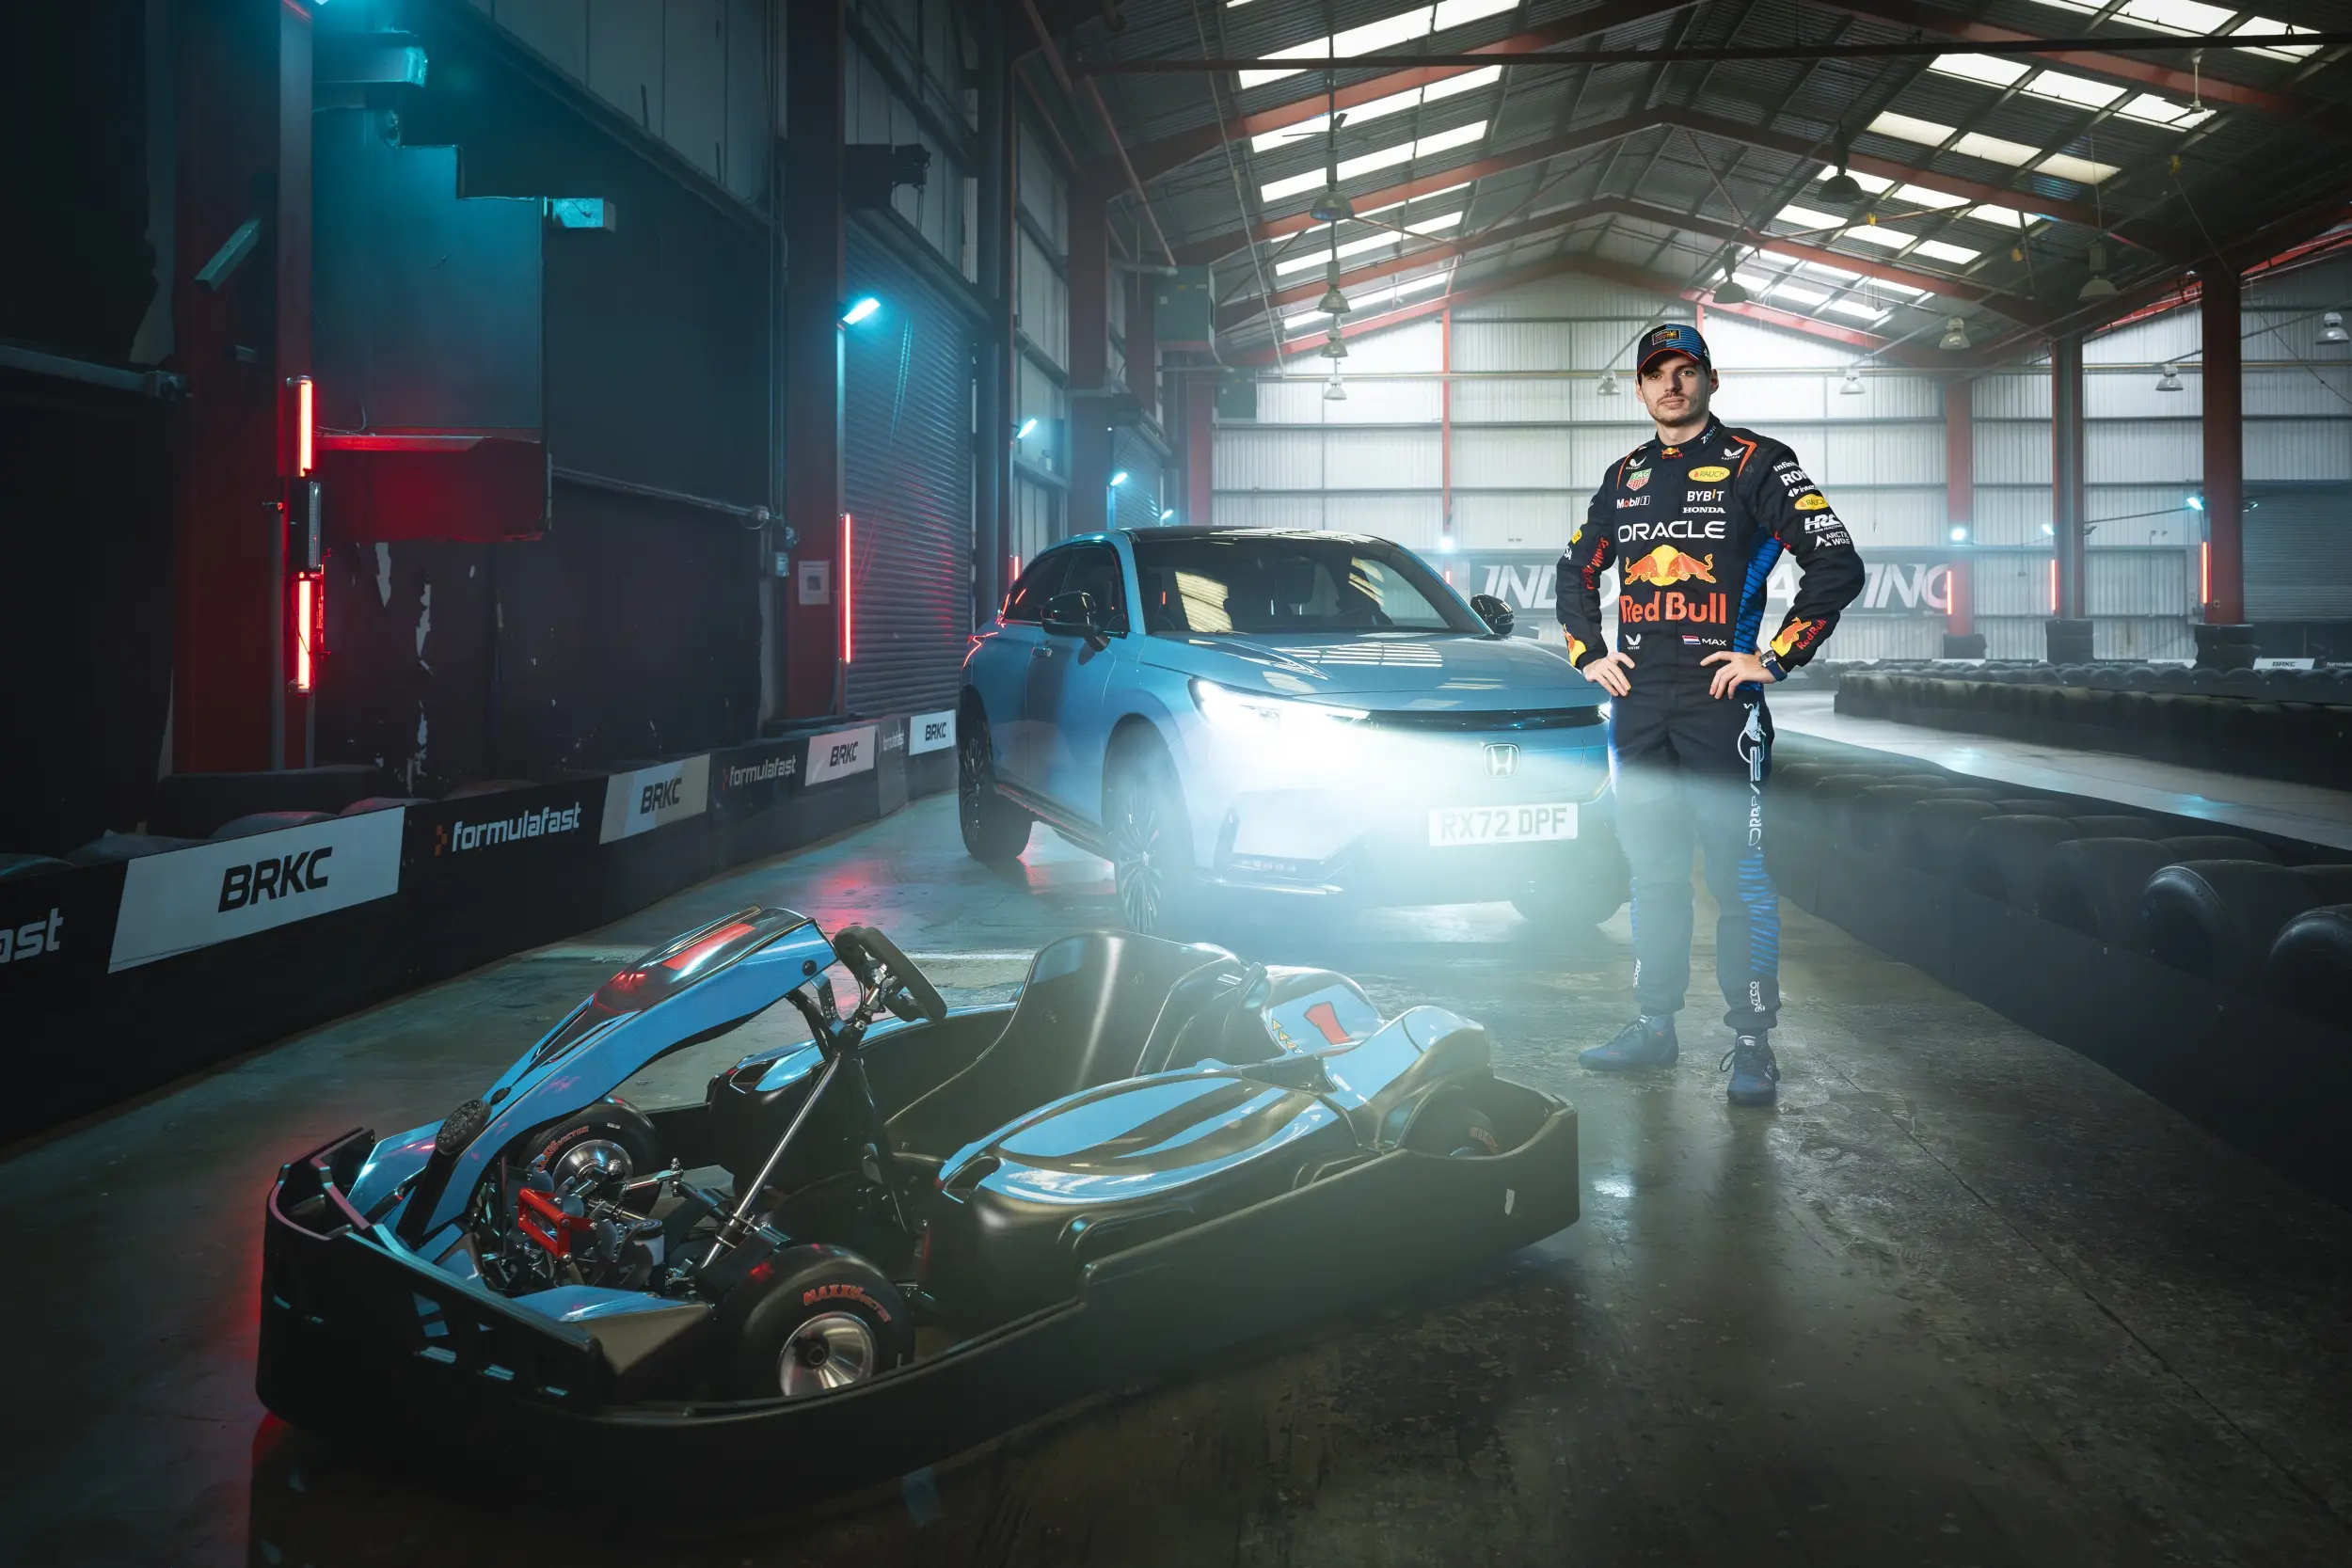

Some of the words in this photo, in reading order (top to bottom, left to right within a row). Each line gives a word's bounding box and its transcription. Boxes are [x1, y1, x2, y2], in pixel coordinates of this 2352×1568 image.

[1632, 470, 1649, 479] TAG
[1616, 497, 1640, 509] Mobil
[1687, 489, 1724, 502] BYBIT
[1618, 520, 1726, 543] ORACLE
[1619, 591, 1661, 624] Red
[1665, 592, 1726, 625] Bull
[1702, 638, 1726, 646] MAX
[1796, 632, 1814, 650] Red
[924, 722, 947, 741] BRKC
[830, 741, 859, 767] BRKC
[729, 754, 797, 787] formulafast
[640, 777, 681, 815] BRKC
[452, 801, 581, 852] formulafast
[1440, 809, 1510, 841] RX72
[1518, 807, 1567, 835] DPF
[217, 847, 333, 913] BRKC
